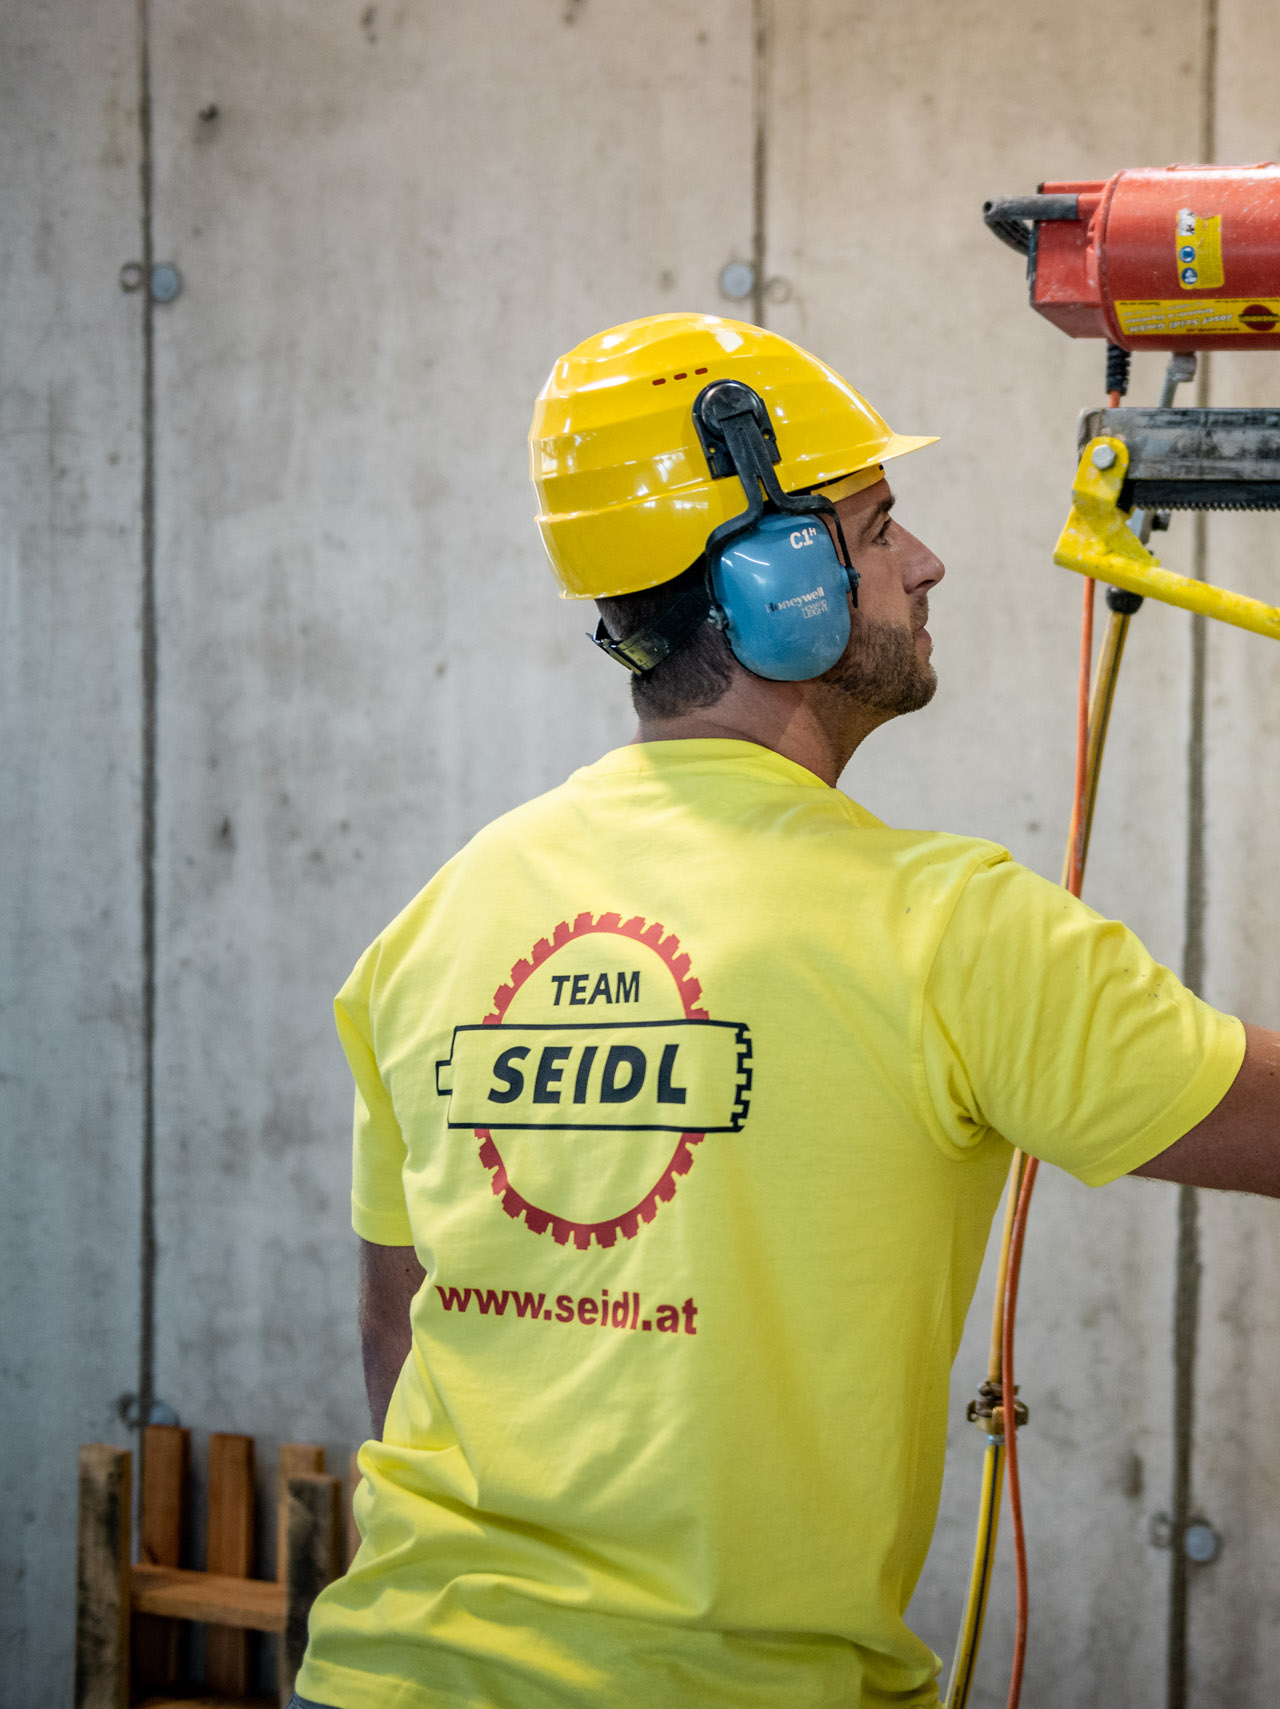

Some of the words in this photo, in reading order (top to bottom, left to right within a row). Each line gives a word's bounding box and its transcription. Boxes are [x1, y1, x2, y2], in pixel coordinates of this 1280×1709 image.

[1169, 318, 1199, 329] Seidl
[1202, 313, 1233, 325] Josef
[765, 586, 825, 613] Honeywell
[551, 971, 640, 1006] TEAM
[487, 1044, 688, 1105] SEIDL
[435, 1285, 698, 1335] www.seidl.at
